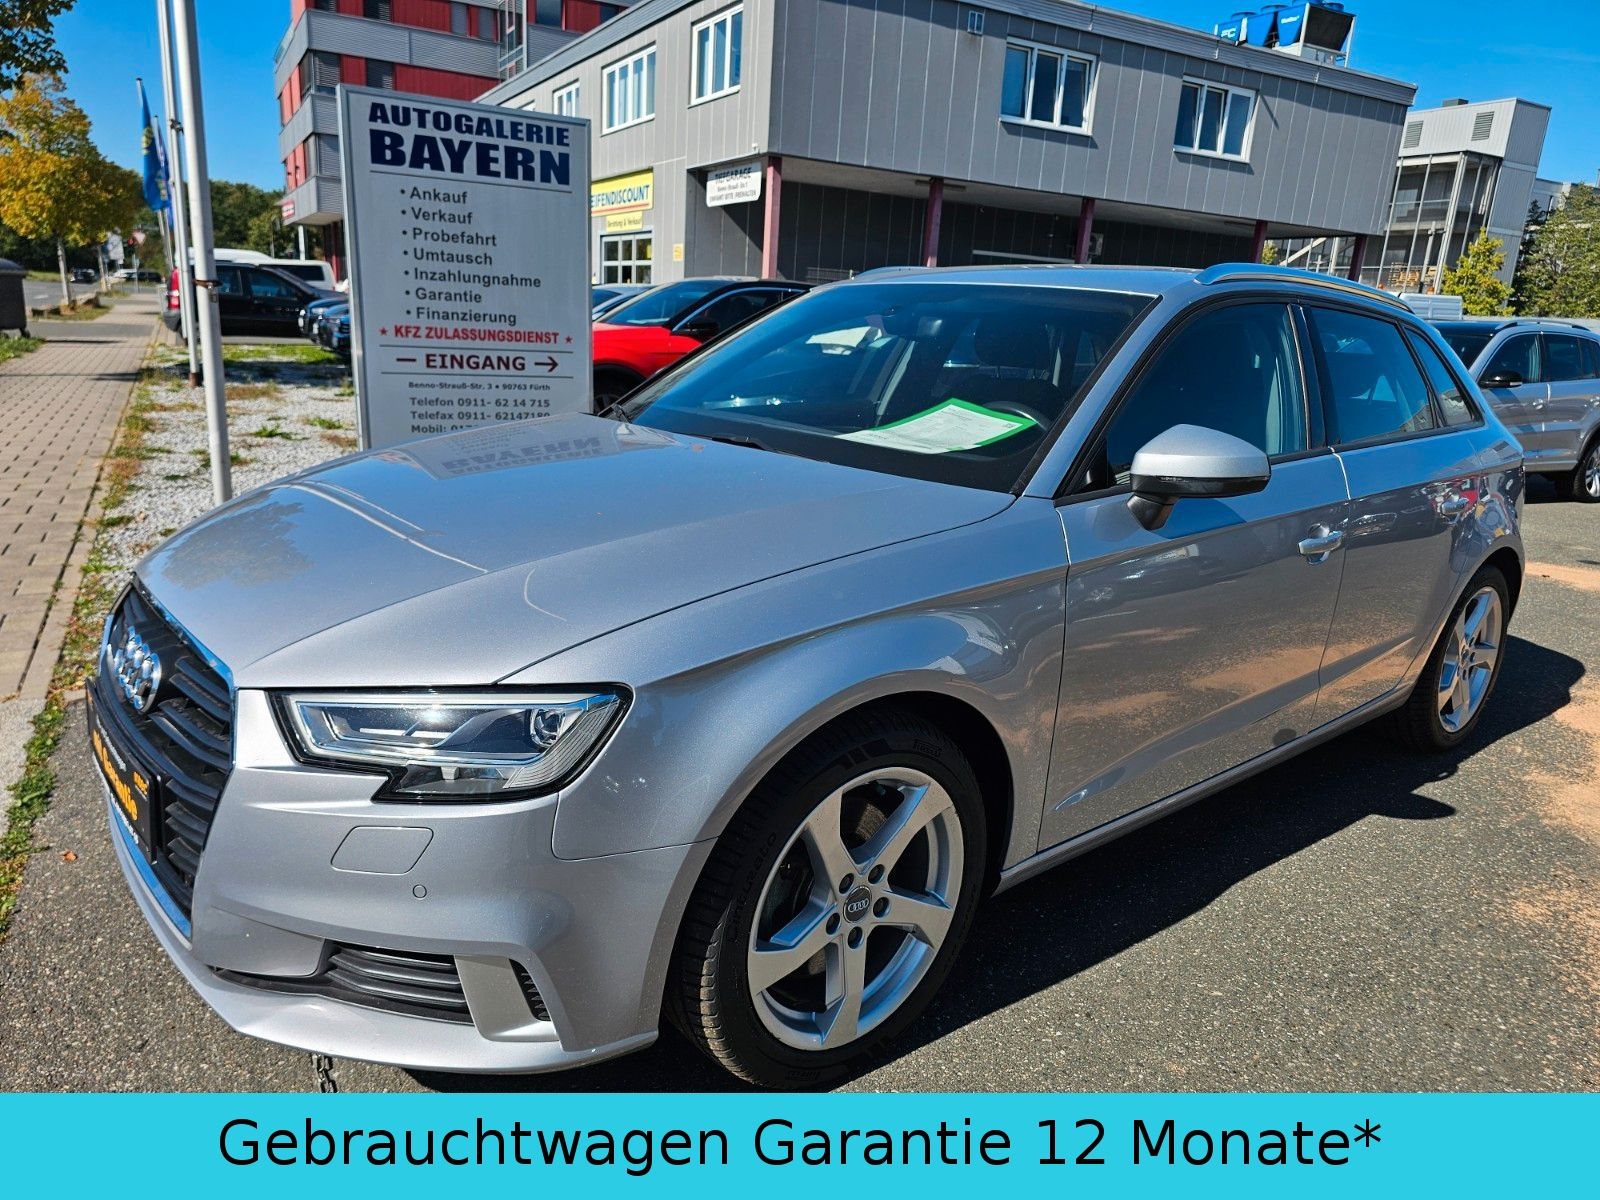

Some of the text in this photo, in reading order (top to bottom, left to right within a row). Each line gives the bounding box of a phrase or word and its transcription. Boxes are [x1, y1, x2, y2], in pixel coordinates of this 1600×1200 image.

[369, 102, 570, 147] AUTOGALERIE
[369, 129, 570, 186] BAYERN
[410, 187, 468, 204] Ankauf
[411, 207, 473, 225] Verkauf
[413, 228, 497, 246] Probefahrt
[414, 247, 493, 266] Umtausch
[414, 267, 541, 288] Inzahlungnahme
[415, 287, 482, 304] Garantie
[416, 307, 517, 326] Finanzierung
[394, 325, 560, 345] KFZ ZULASSUNGSDIENST
[425, 353, 526, 371] EINGANG
[529, 383, 551, 391] Fürth
[410, 397, 550, 408] Telefon 0911- 62 14 715
[410, 411, 454, 420] Telefax
[457, 411, 491, 420] 0911-
[411, 425, 447, 433] Mobil:
